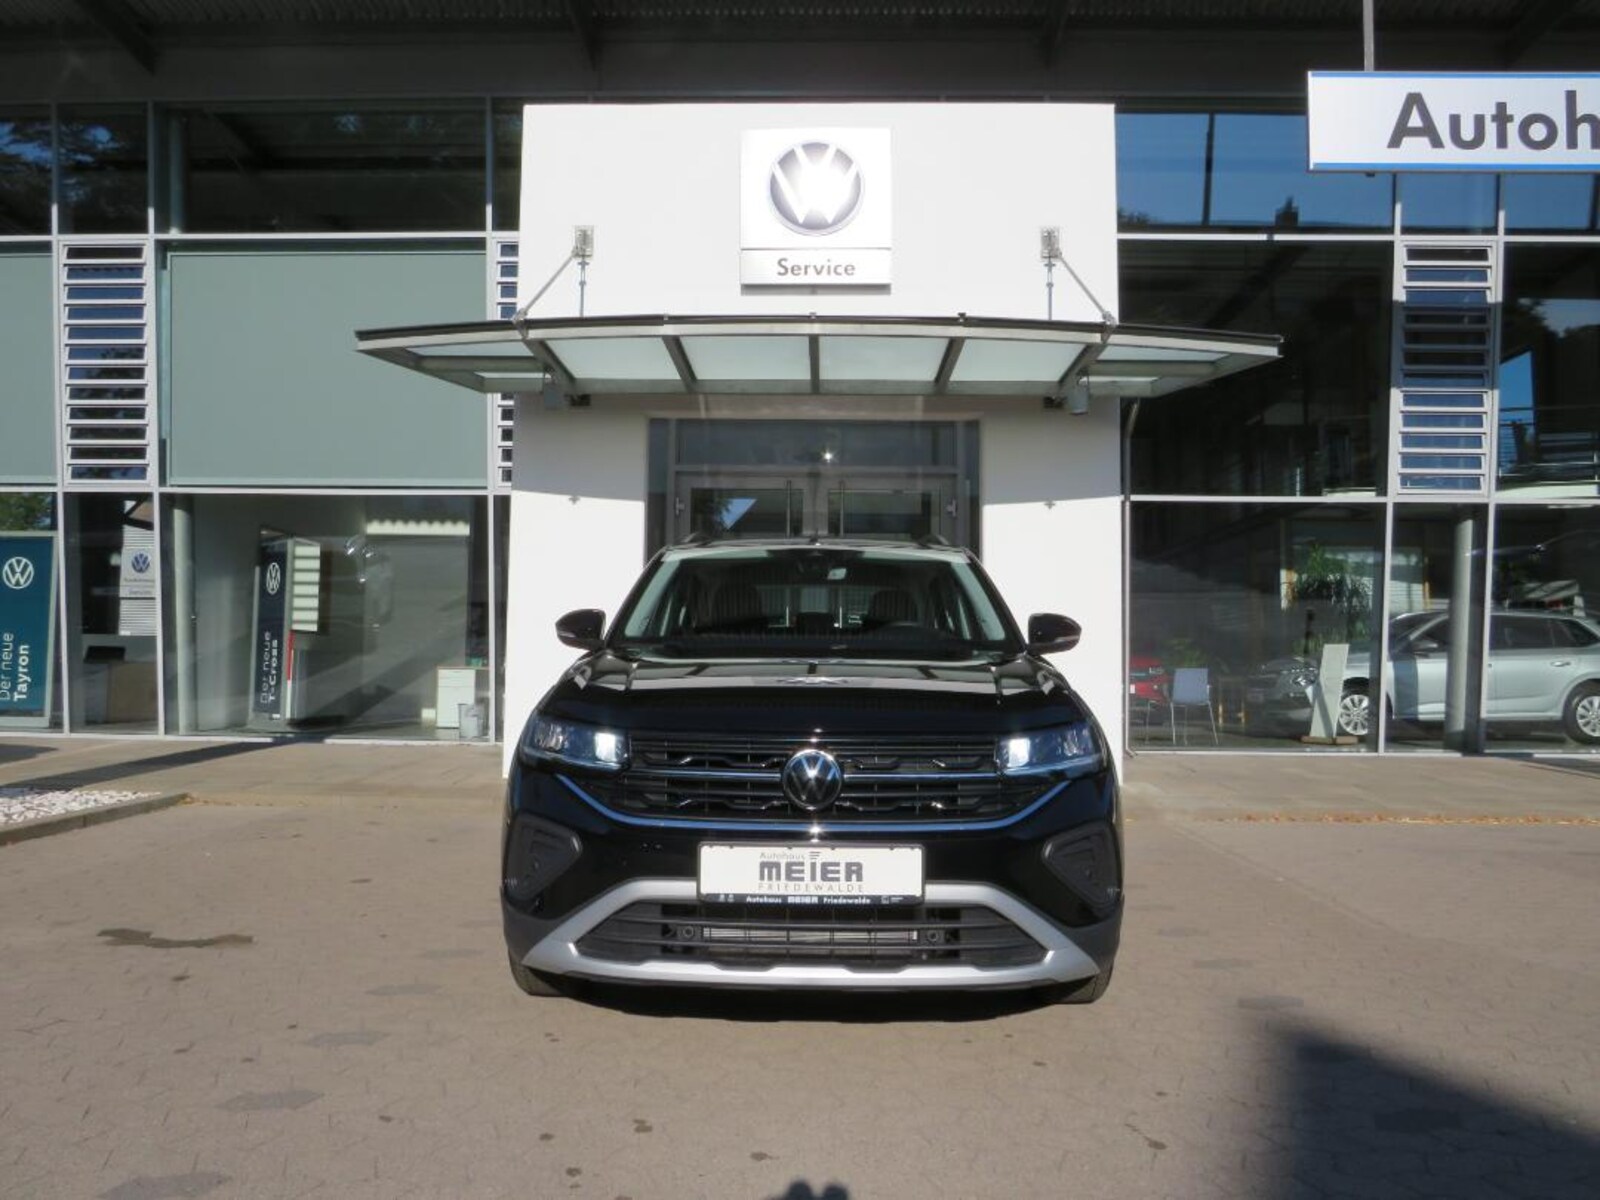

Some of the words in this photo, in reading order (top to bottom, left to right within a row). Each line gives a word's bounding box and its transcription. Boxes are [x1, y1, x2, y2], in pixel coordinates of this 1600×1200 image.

[1387, 89, 1600, 151] Autoh
[777, 258, 856, 276] Service
[1, 631, 14, 671] neue
[263, 631, 272, 671] neue
[14, 644, 31, 702] Tayron
[268, 639, 279, 703] T-Cross
[0, 675, 11, 701] Der
[260, 677, 269, 704] Der
[760, 851, 806, 860] Autohaus
[746, 895, 782, 904] Autohaus
[787, 895, 819, 904] MEIER
[823, 895, 872, 905] Friedewalde
[758, 882, 865, 893] FRIEDEWALDE
